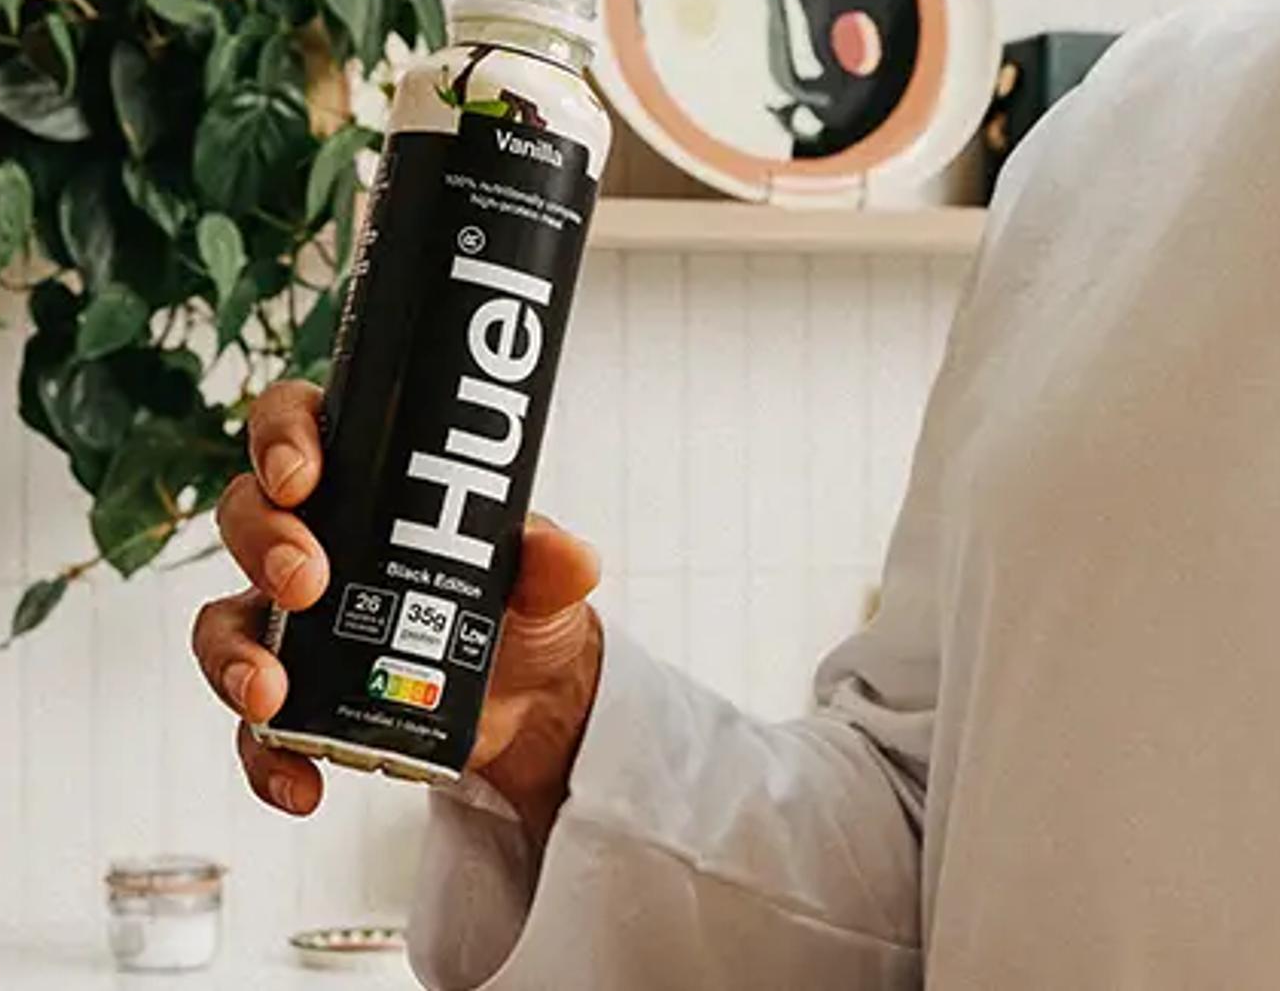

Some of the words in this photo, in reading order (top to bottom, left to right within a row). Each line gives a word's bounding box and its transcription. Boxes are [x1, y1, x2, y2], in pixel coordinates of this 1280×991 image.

[495, 128, 563, 168] Vanilla
[386, 561, 431, 585] Black
[433, 572, 482, 599] Edition
[407, 602, 447, 633] 35g
